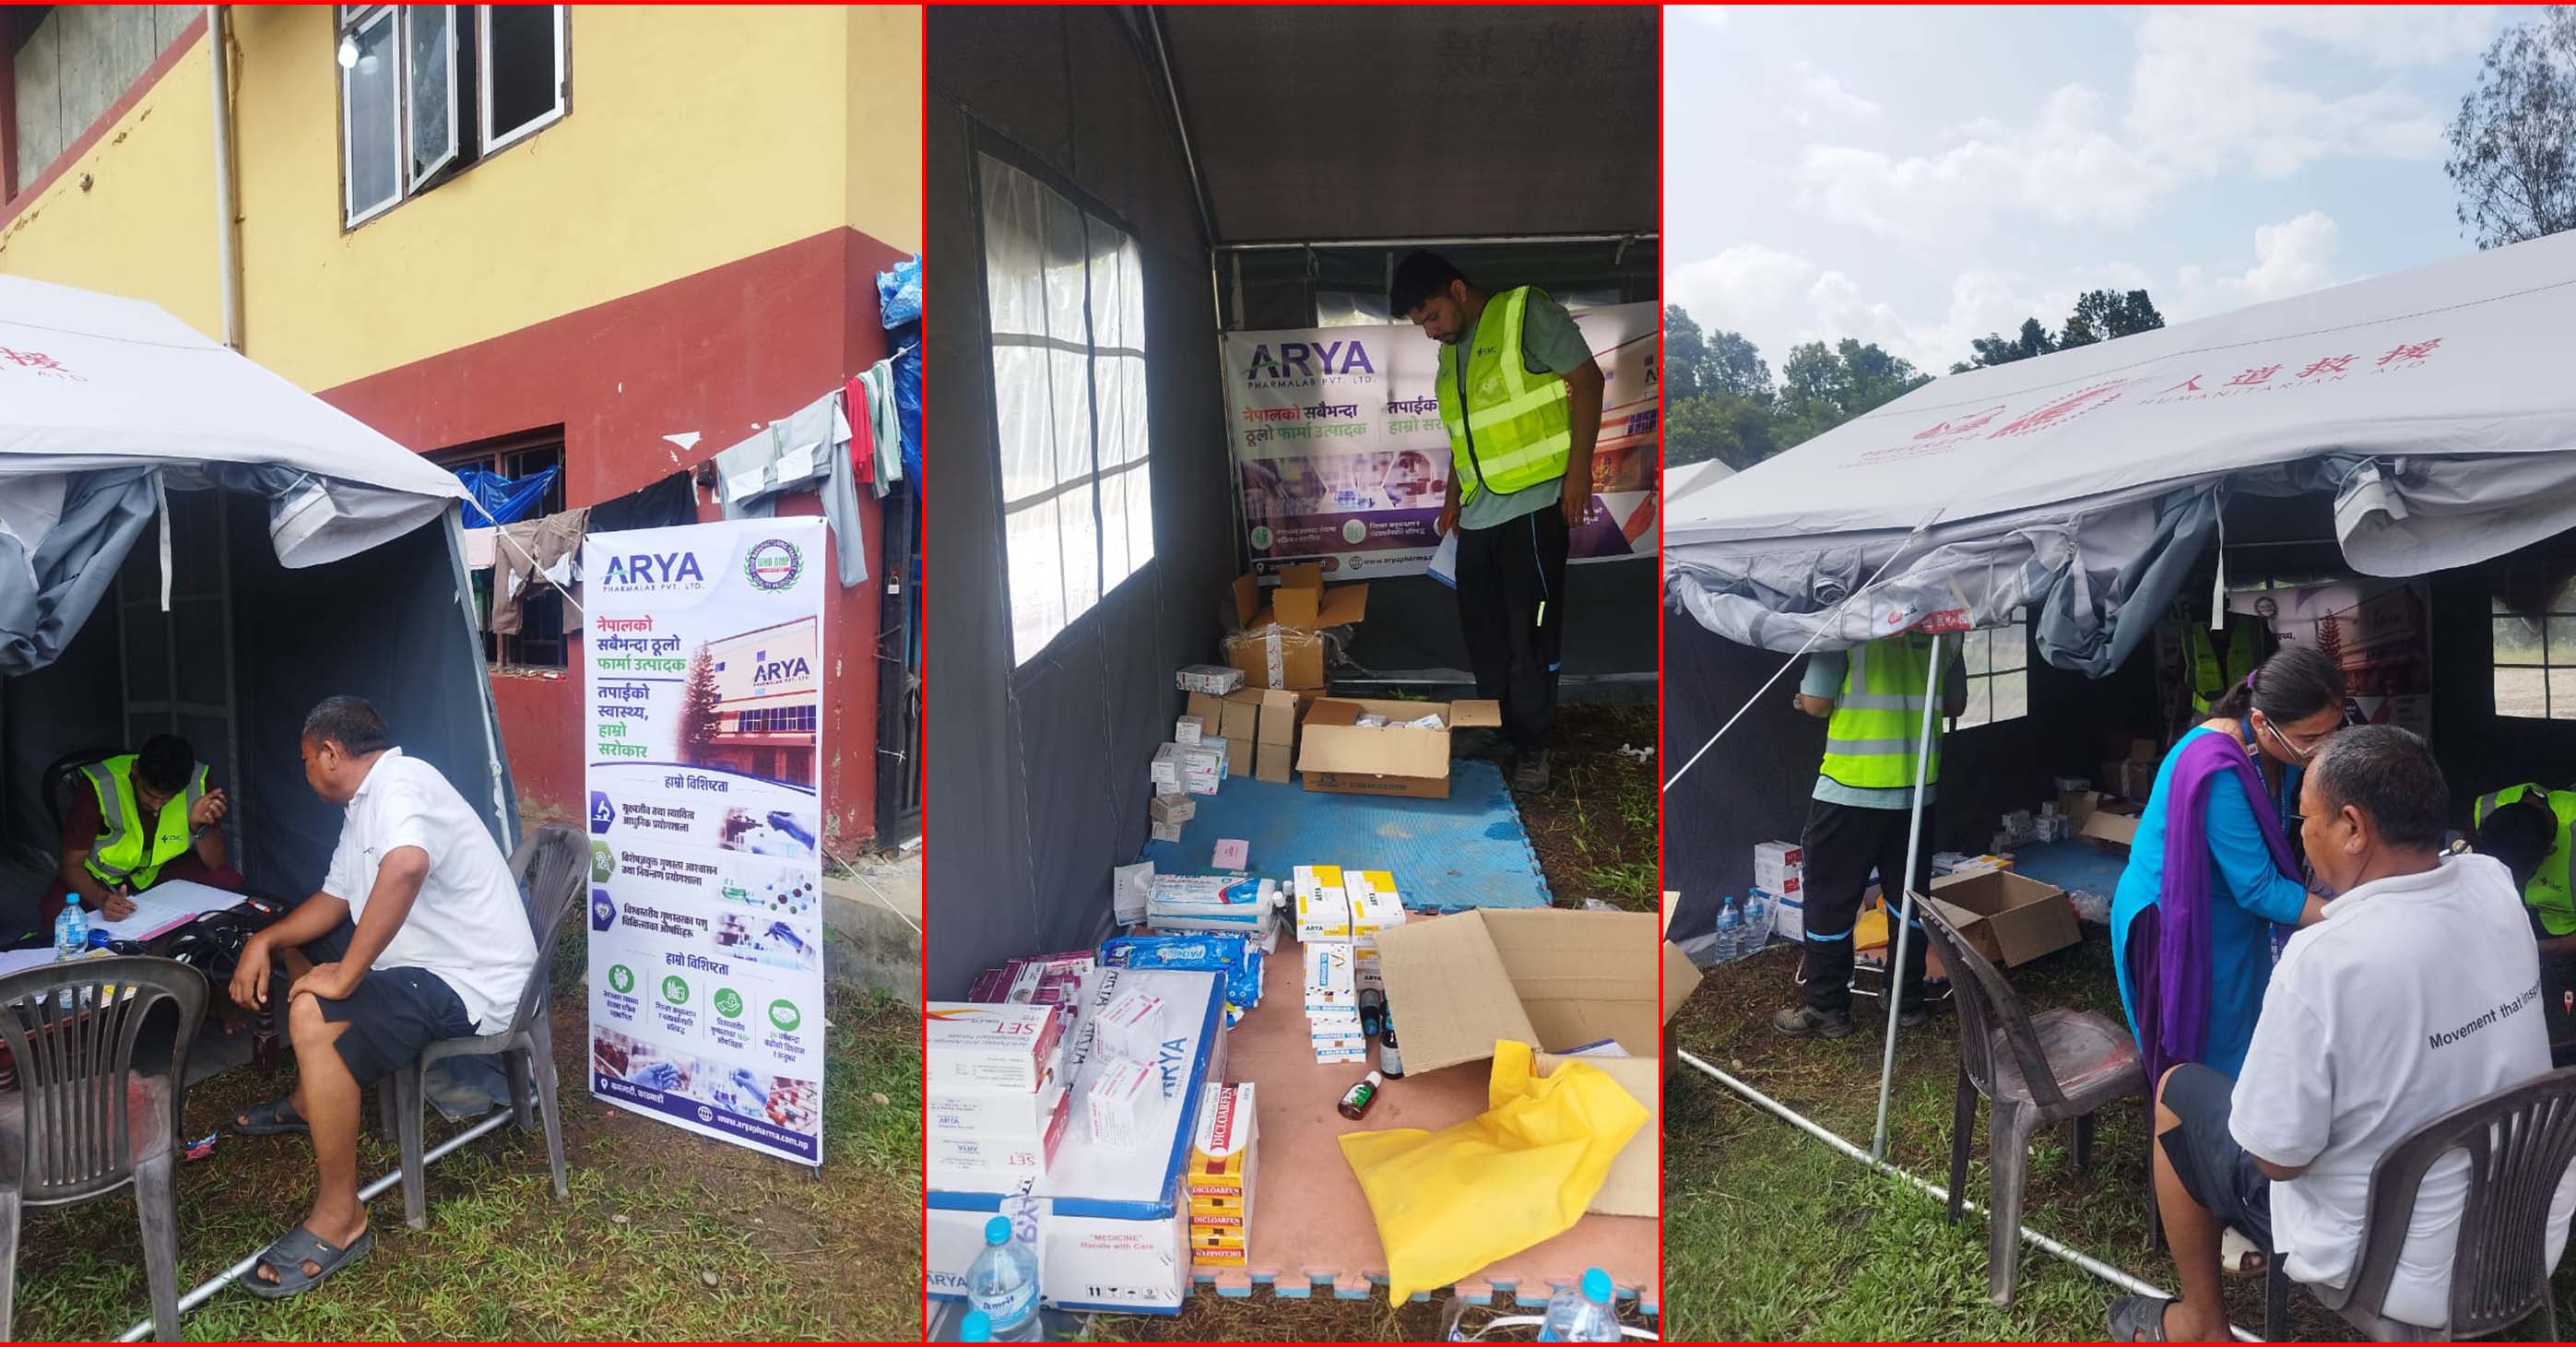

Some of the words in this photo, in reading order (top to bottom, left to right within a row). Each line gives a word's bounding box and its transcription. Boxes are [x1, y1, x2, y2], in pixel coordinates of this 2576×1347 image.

[1247, 340, 1375, 380] ARYA
[1248, 378, 1315, 391] PHARMALAB
[1243, 403, 1301, 423] नेपालको
[1303, 400, 1358, 420] सबैभन्दा
[1387, 396, 1438, 416] तपाईक
[1244, 425, 1274, 447] ठूलो
[1277, 420, 1312, 441] फार्मा
[1314, 422, 1368, 439] उत्पादक
[1387, 416, 1419, 435] हाम्रो
[604, 551, 703, 585] ARYA
[603, 585, 656, 593] PHARMALAB
[597, 615, 653, 632] नेपालको
[597, 634, 649, 652] सबैभन्दा
[651, 634, 680, 656] ठूलो
[597, 653, 632, 672] फार्मा
[634, 658, 686, 674] उत्पादक
[754, 657, 810, 682] ARYA
[597, 682, 650, 702] तपाईको
[597, 704, 650, 721] स्वास्थ्य,
[598, 722, 627, 738] हाम्रो
[598, 741, 647, 759] सरोकार
[665, 774, 684, 789] हाम्रो
[687, 775, 728, 793] विशिष्टता
[666, 951, 685, 967] हाम्रो
[687, 954, 729, 975] विशिष्टता
[991, 1022, 1037, 1034] SET
[2428, 1009, 2498, 1050] Movement
[2499, 995, 2523, 1019] that
[1212, 1086, 1233, 1147] DICLOARFEN
[716, 1114, 809, 1152] www.aryapharma.com.np
[1007, 1156, 1035, 1166] SET
[1192, 1187, 1240, 1195] DICLOARFEN
[1193, 1216, 1240, 1225] DICLOARFEN
[1134, 1243, 1154, 1251] Care
[927, 1273, 968, 1288] ARYA
